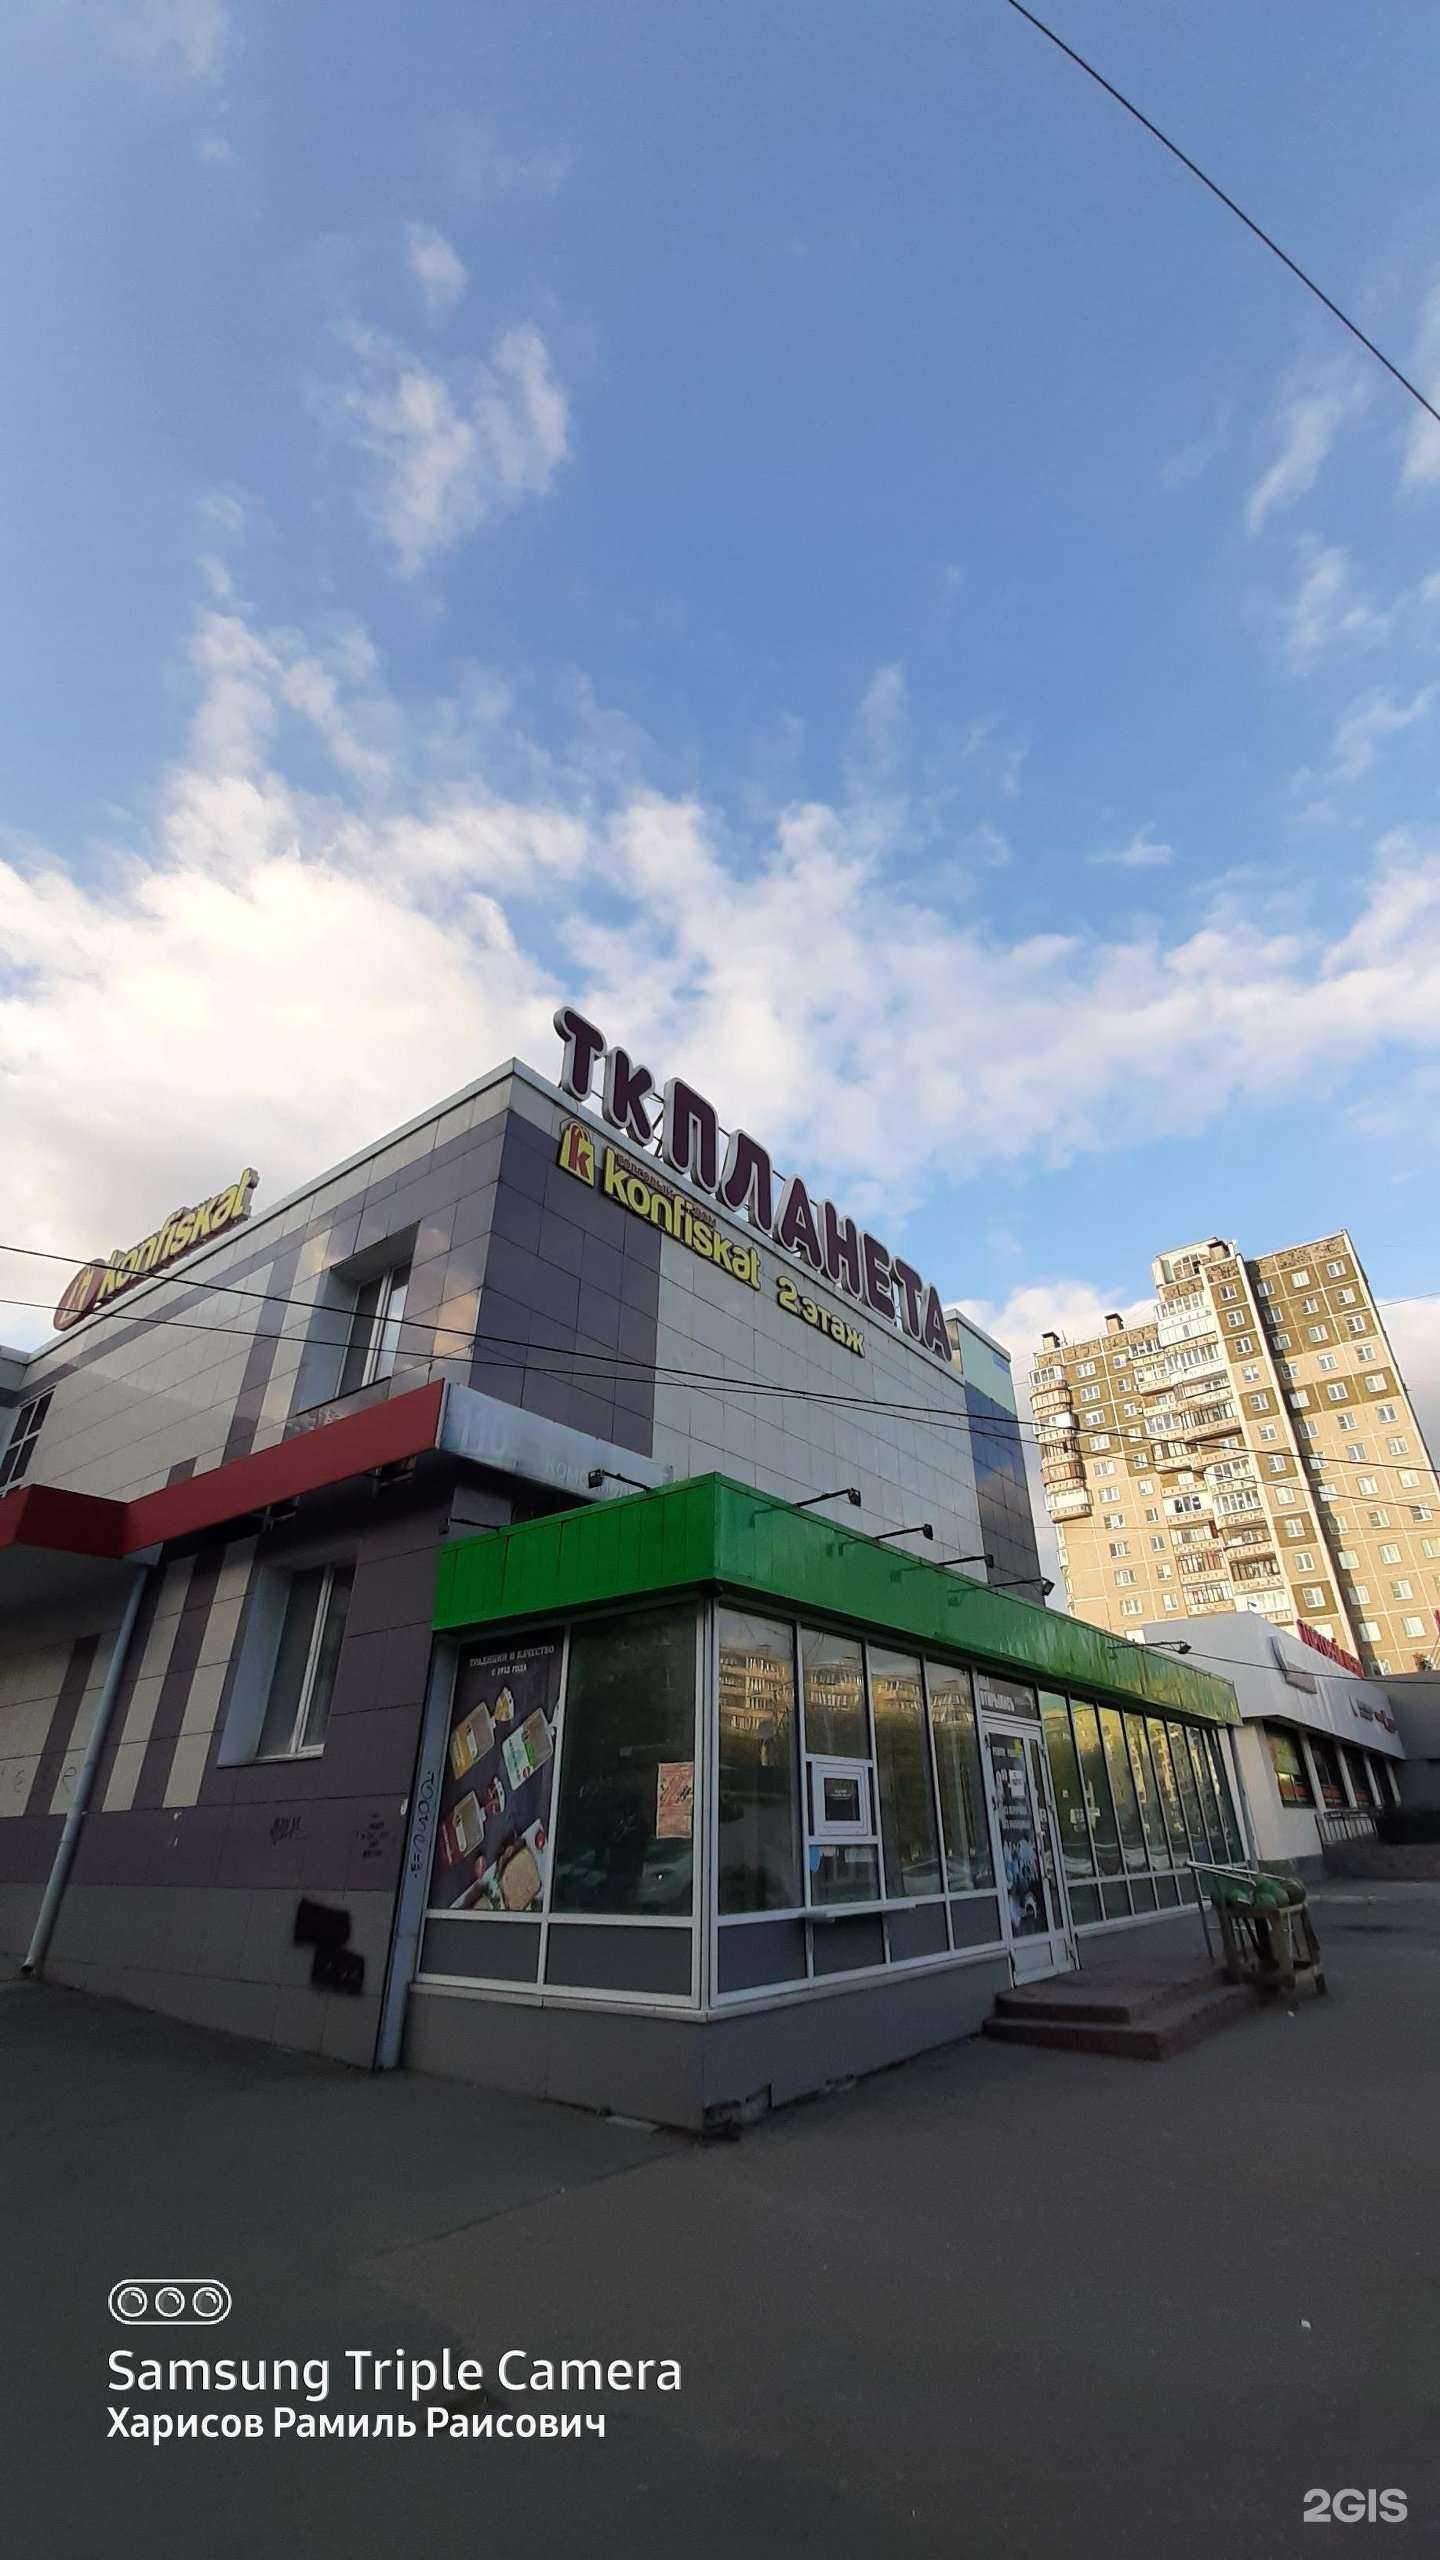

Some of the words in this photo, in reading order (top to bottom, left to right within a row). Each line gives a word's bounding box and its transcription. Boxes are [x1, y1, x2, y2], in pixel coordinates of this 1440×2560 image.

[97, 1167, 259, 1303] konfiskat
[553, 1006, 656, 1147] ТК
[663, 1077, 953, 1363] ПЛАНЕТА
[602, 1146, 762, 1291] konfiskat
